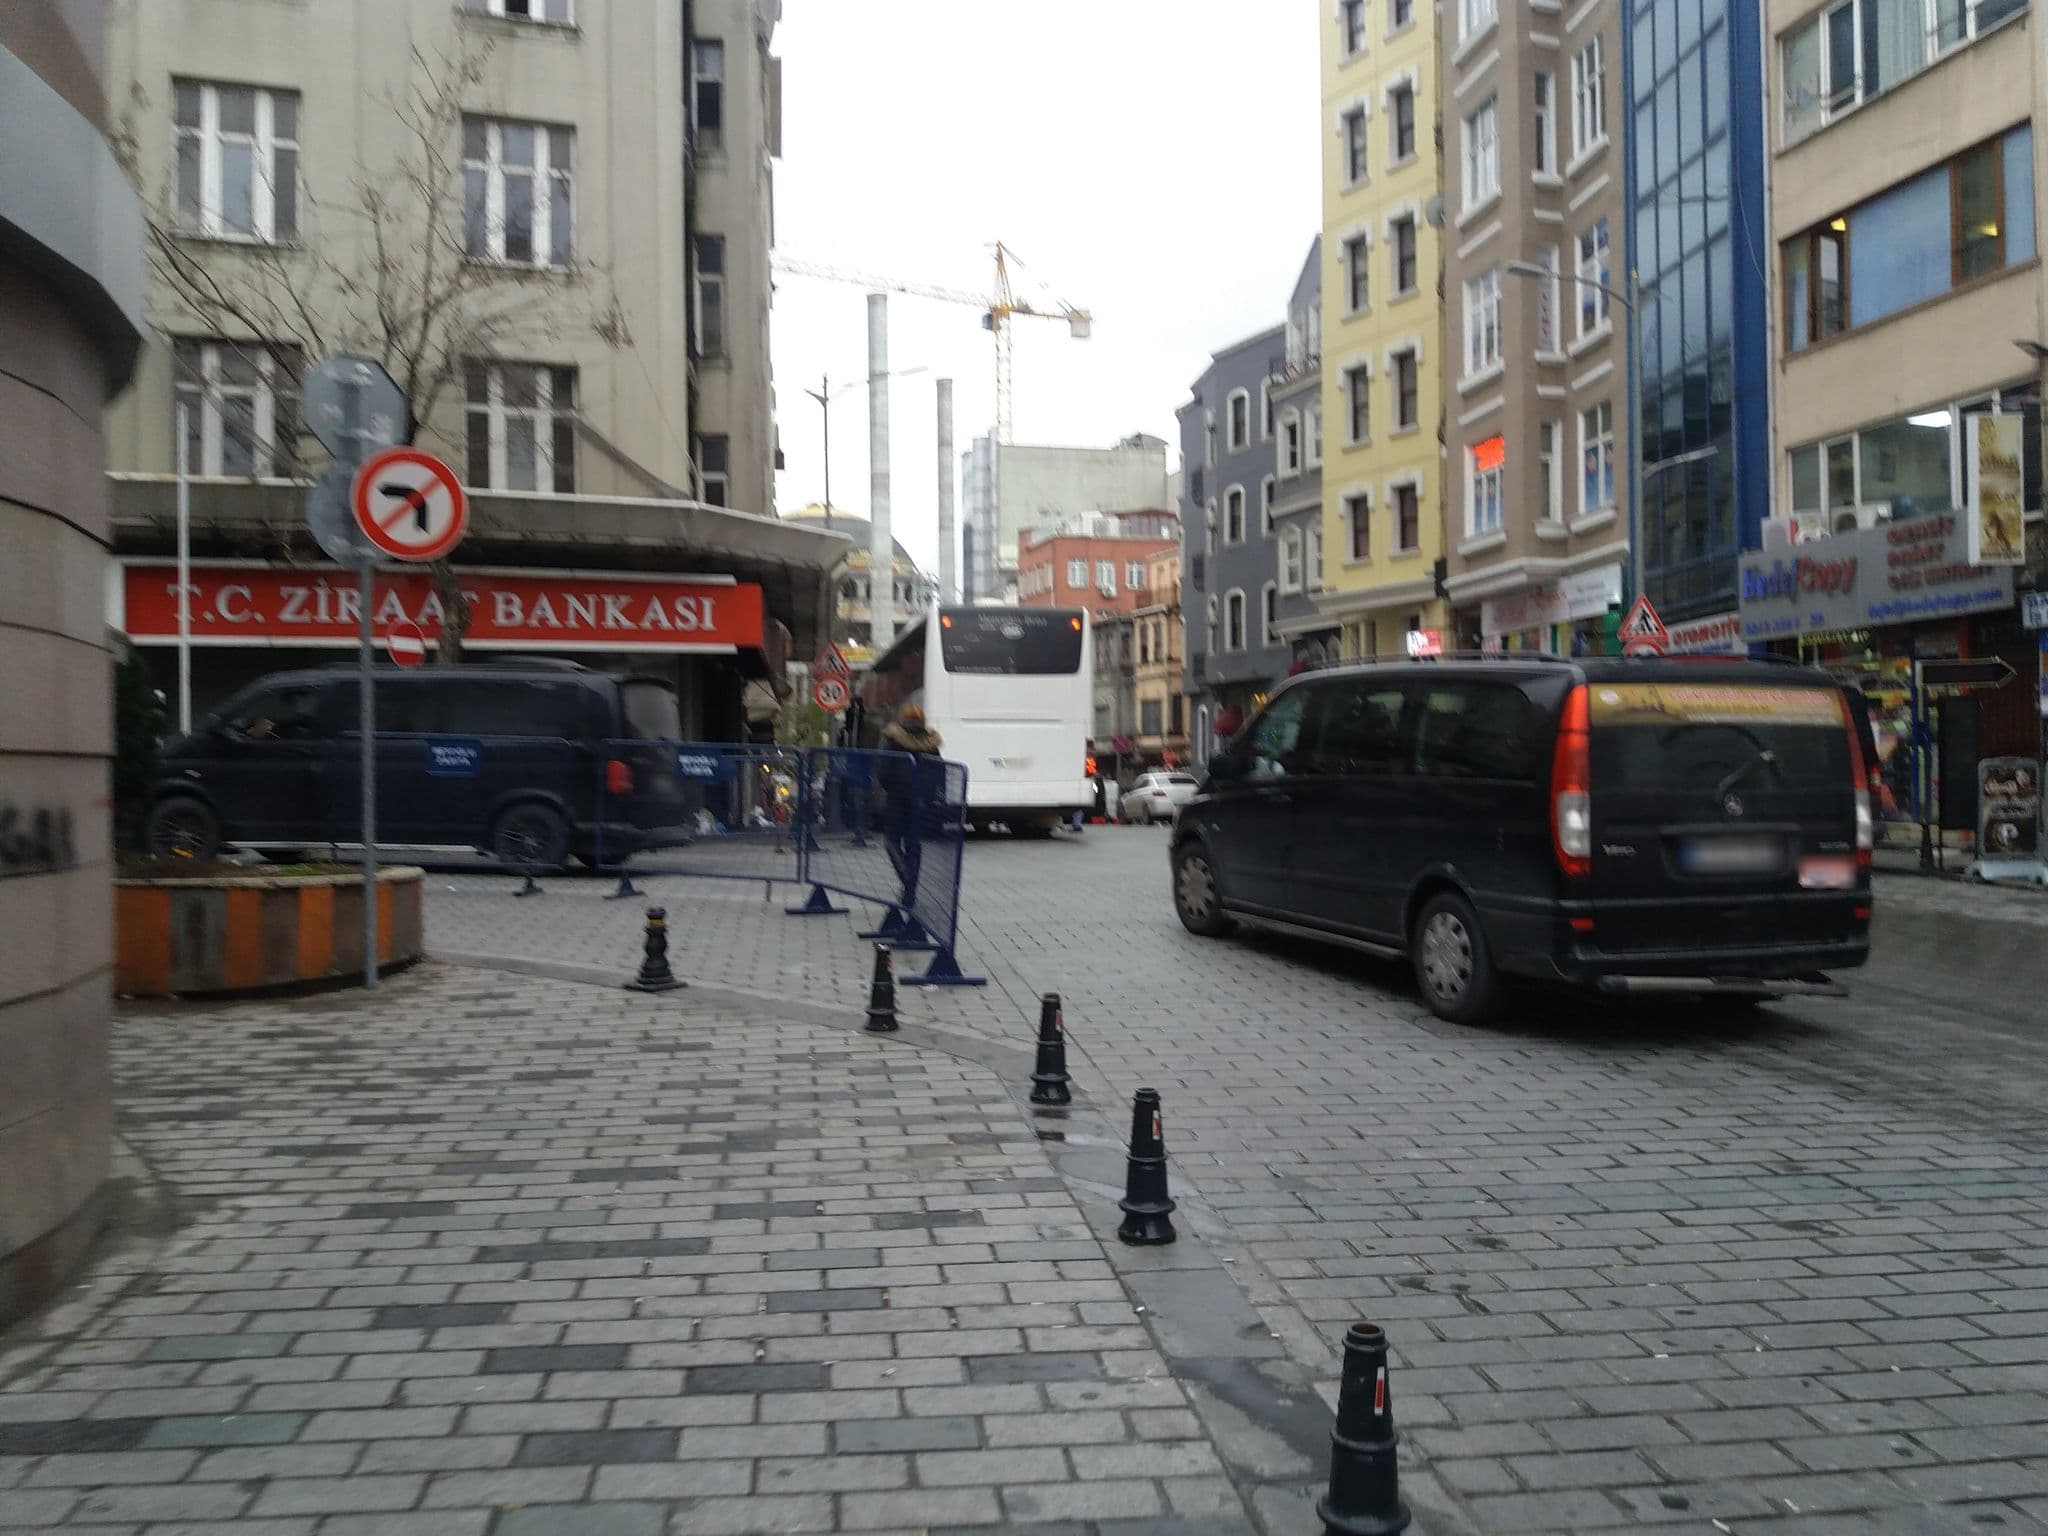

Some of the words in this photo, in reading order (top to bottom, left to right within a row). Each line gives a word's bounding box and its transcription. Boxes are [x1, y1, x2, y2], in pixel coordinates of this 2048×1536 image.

[166, 583, 265, 623] T.C.
[278, 577, 480, 625] ZİRAA
[491, 591, 717, 631] BANKASI
